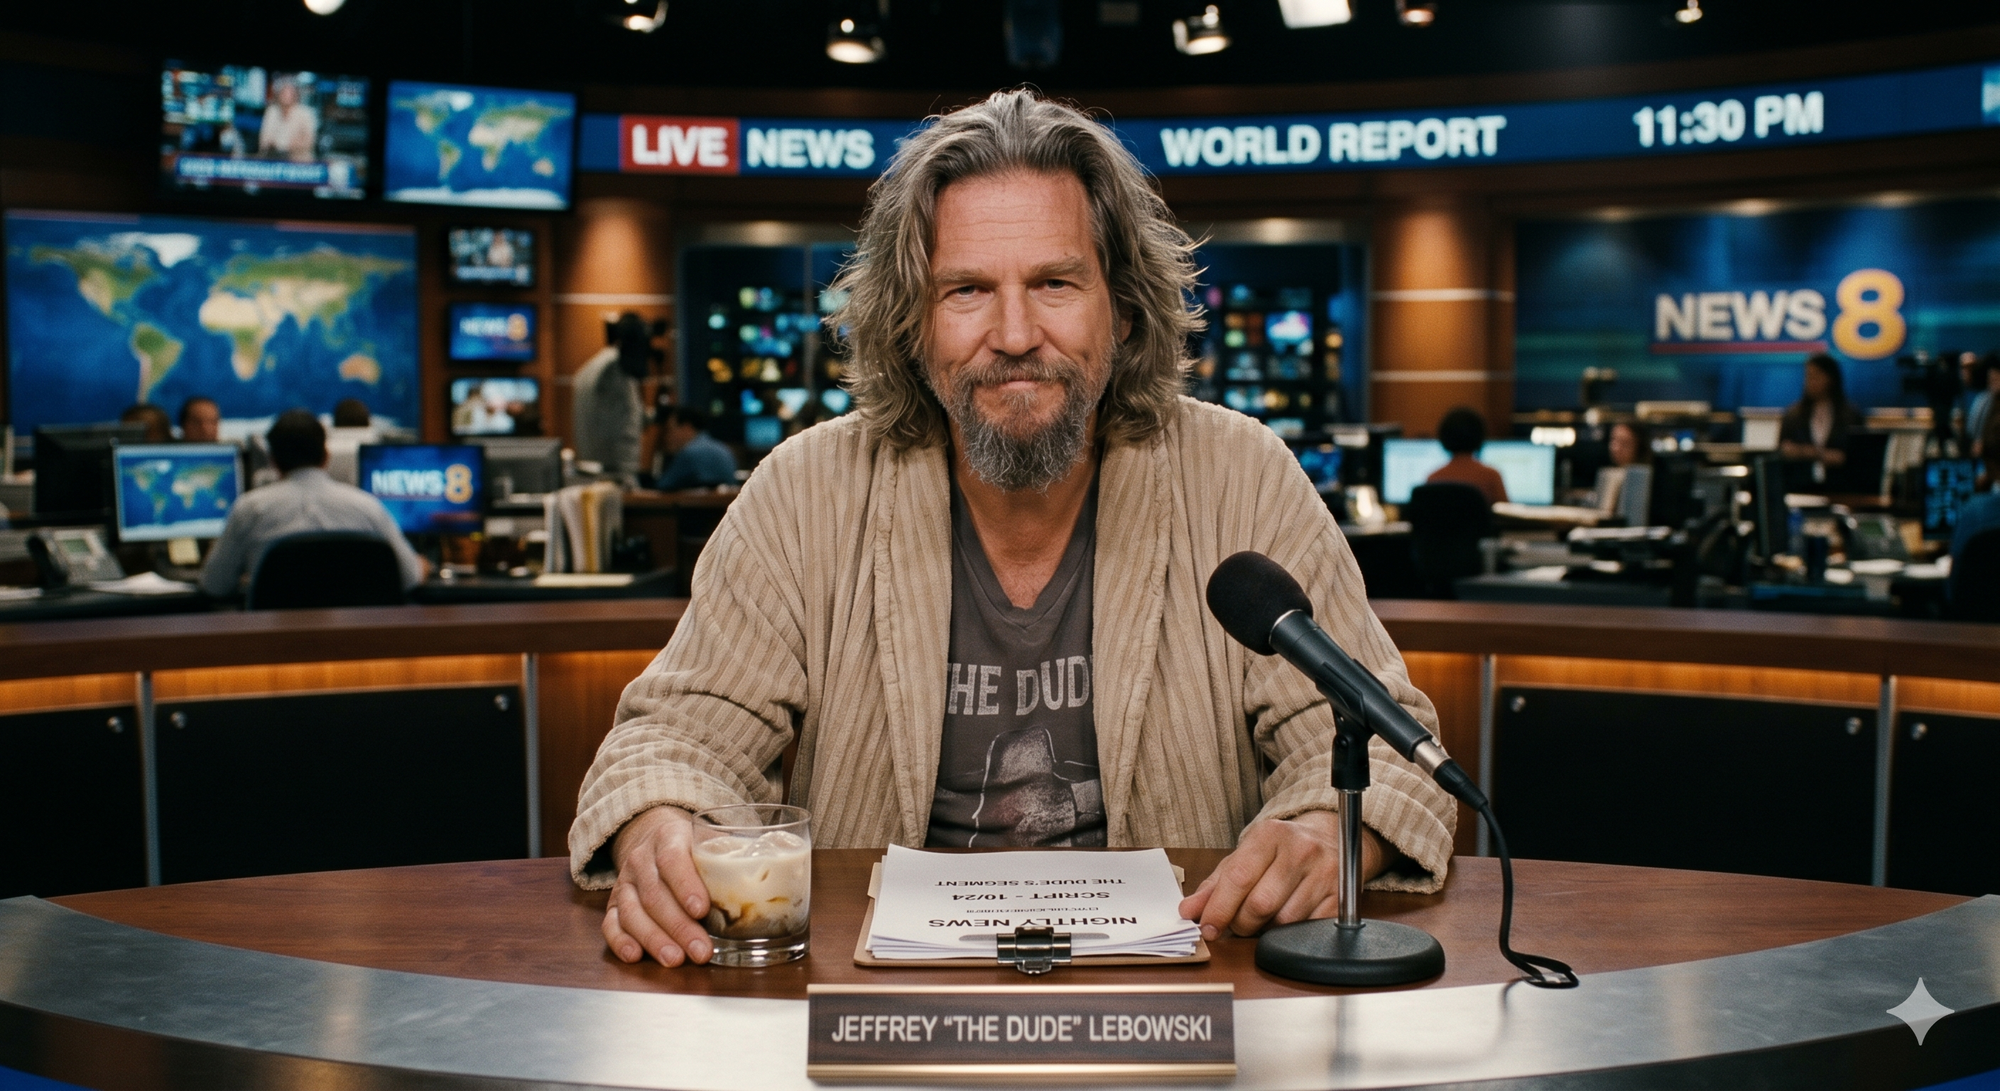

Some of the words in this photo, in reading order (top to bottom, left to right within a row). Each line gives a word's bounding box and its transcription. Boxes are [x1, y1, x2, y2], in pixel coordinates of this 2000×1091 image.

[1633, 99, 1747, 147] 11:30
[1753, 91, 1825, 138] PM
[631, 123, 729, 168] LIVE
[746, 127, 876, 170] NEWS
[1160, 125, 1321, 167] WORLD
[1328, 115, 1507, 162] REPORT
[1654, 288, 1827, 342] NEWS
[1832, 268, 1907, 361] 8
[371, 469, 444, 496] NEWS
[445, 463, 474, 504] 8
[947, 662, 1002, 716] HE
[1015, 654, 1093, 716] DUD
[934, 879, 1019, 887] SEGMENT
[951, 893, 1008, 901] 10/24
[1024, 878, 1087, 886] DUDE'S
[1029, 891, 1111, 900] SCRIPT
[928, 919, 1010, 928] NEWS
[1019, 916, 1137, 927] NIGHTLY
[831, 1014, 938, 1043] JEFFREY
[1089, 1014, 1212, 1042] LEBOWSKI
